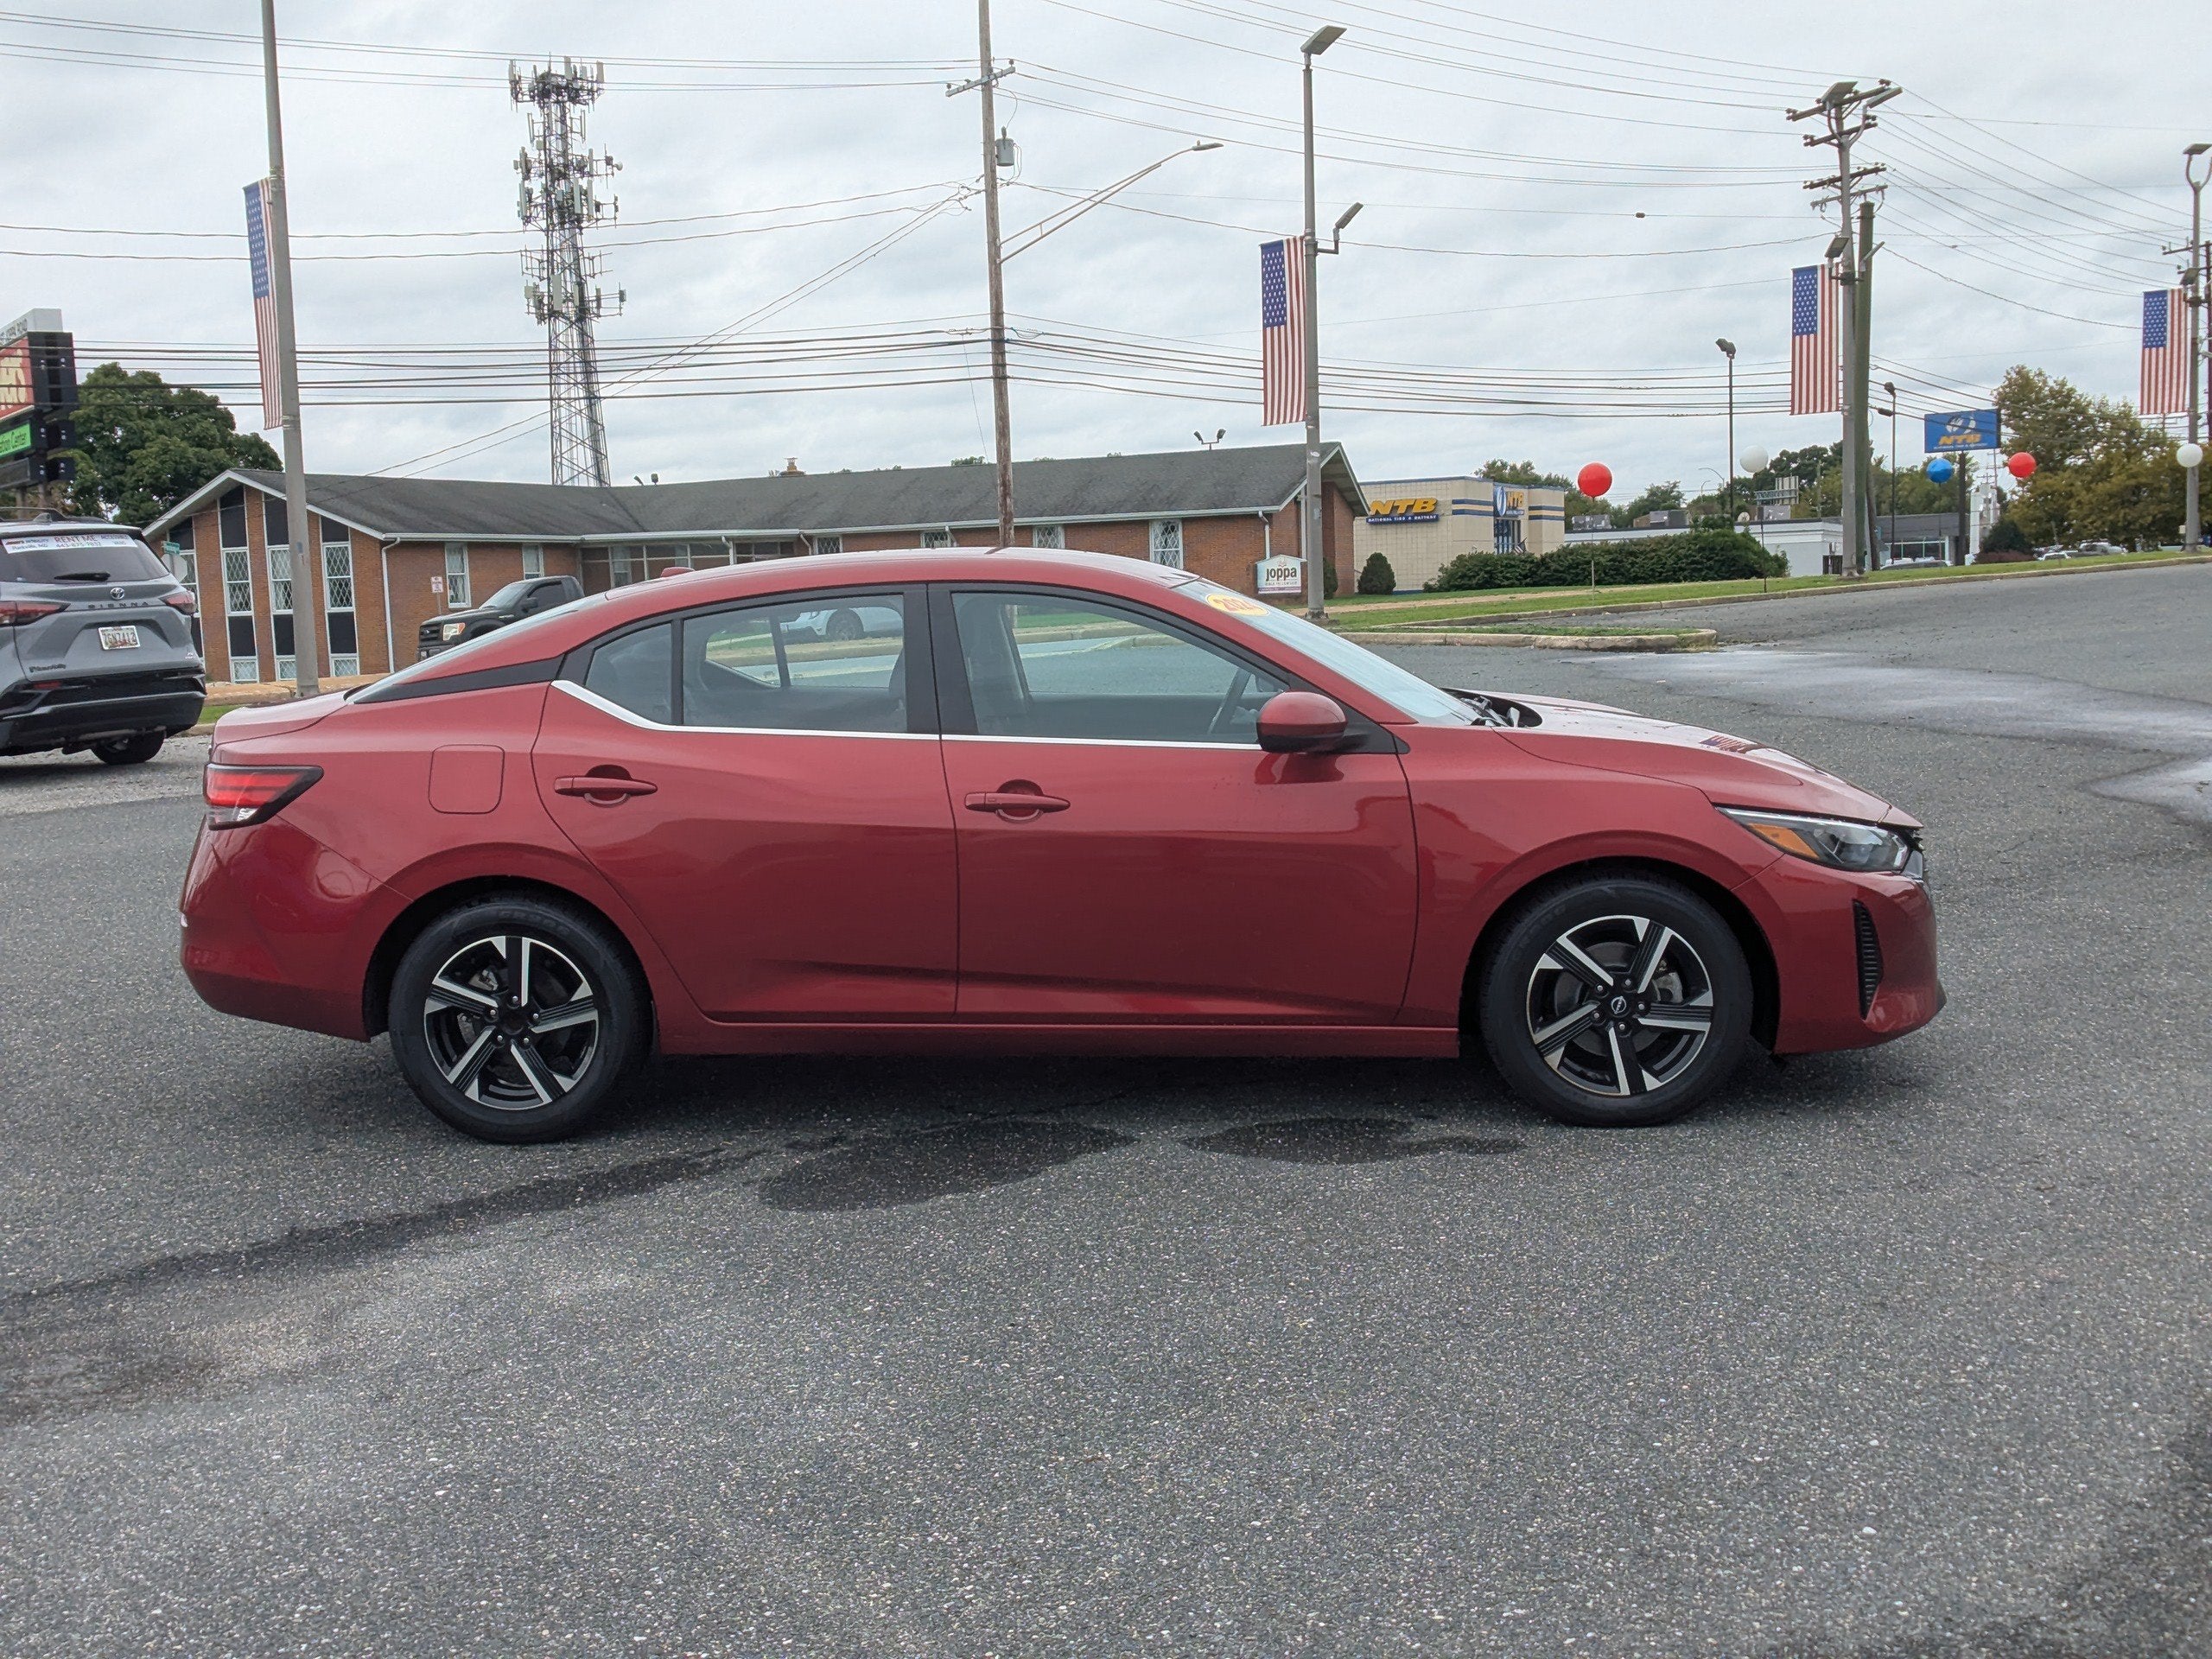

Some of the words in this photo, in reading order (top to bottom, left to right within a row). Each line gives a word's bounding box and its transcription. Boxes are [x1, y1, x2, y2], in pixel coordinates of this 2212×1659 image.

[1369, 497, 1438, 516] NTB
[1507, 491, 1525, 508] NTB
[54, 535, 80, 543] RENT
[1266, 567, 1297, 582] joppa
